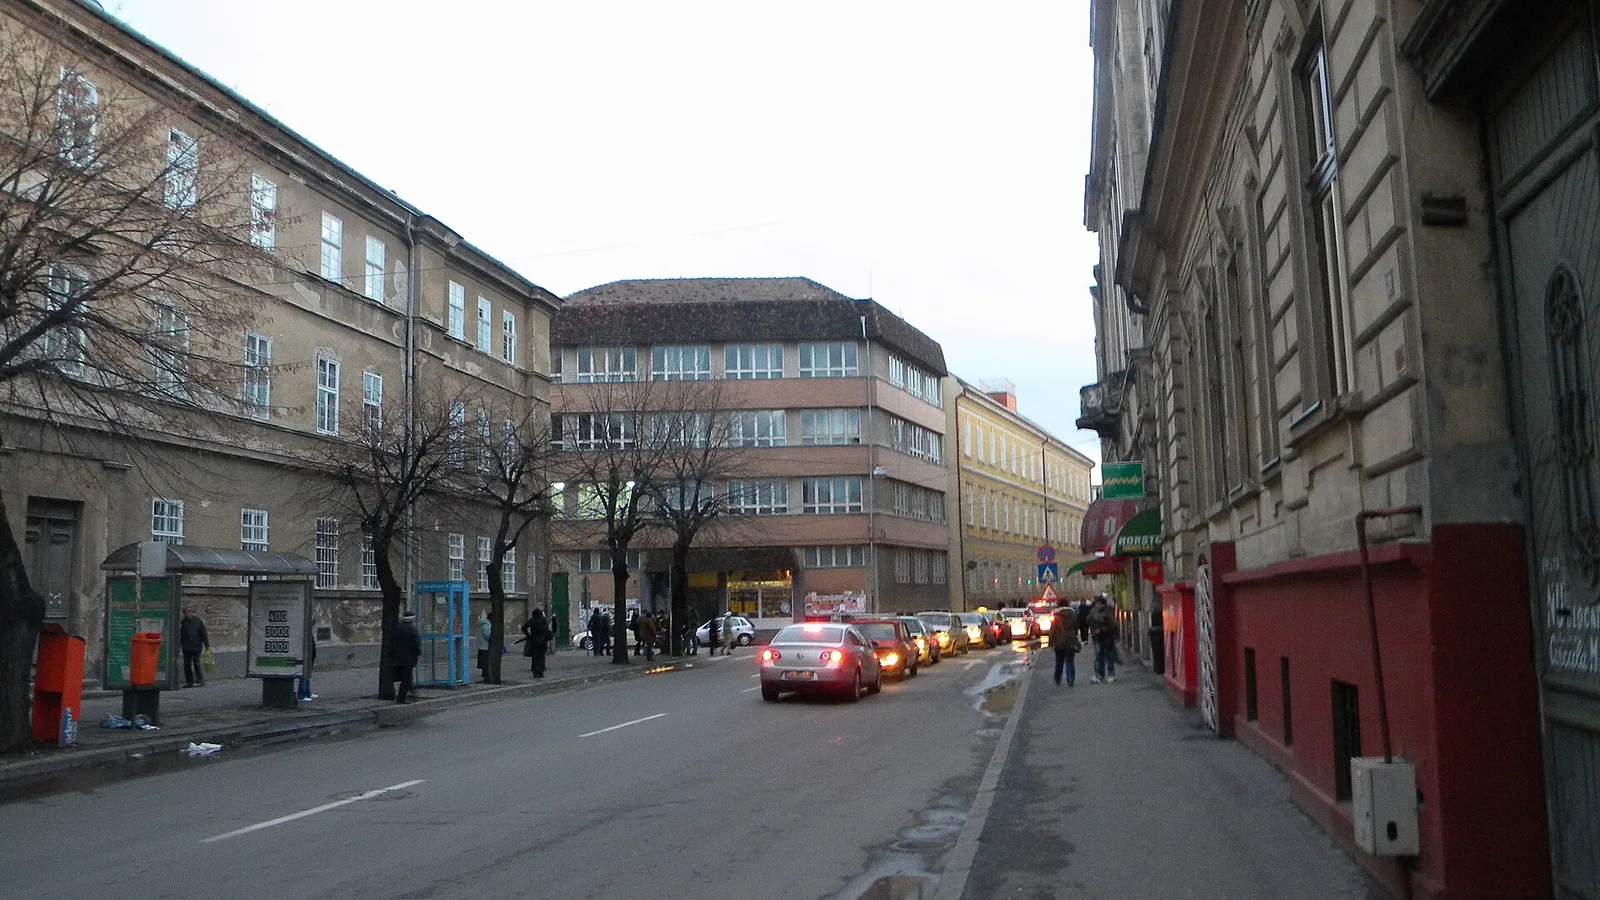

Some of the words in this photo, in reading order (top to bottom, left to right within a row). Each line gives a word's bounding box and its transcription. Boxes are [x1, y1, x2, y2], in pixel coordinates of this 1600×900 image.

[268, 611, 287, 622] 400
[265, 626, 290, 637] 3000
[265, 641, 289, 653] 3000
